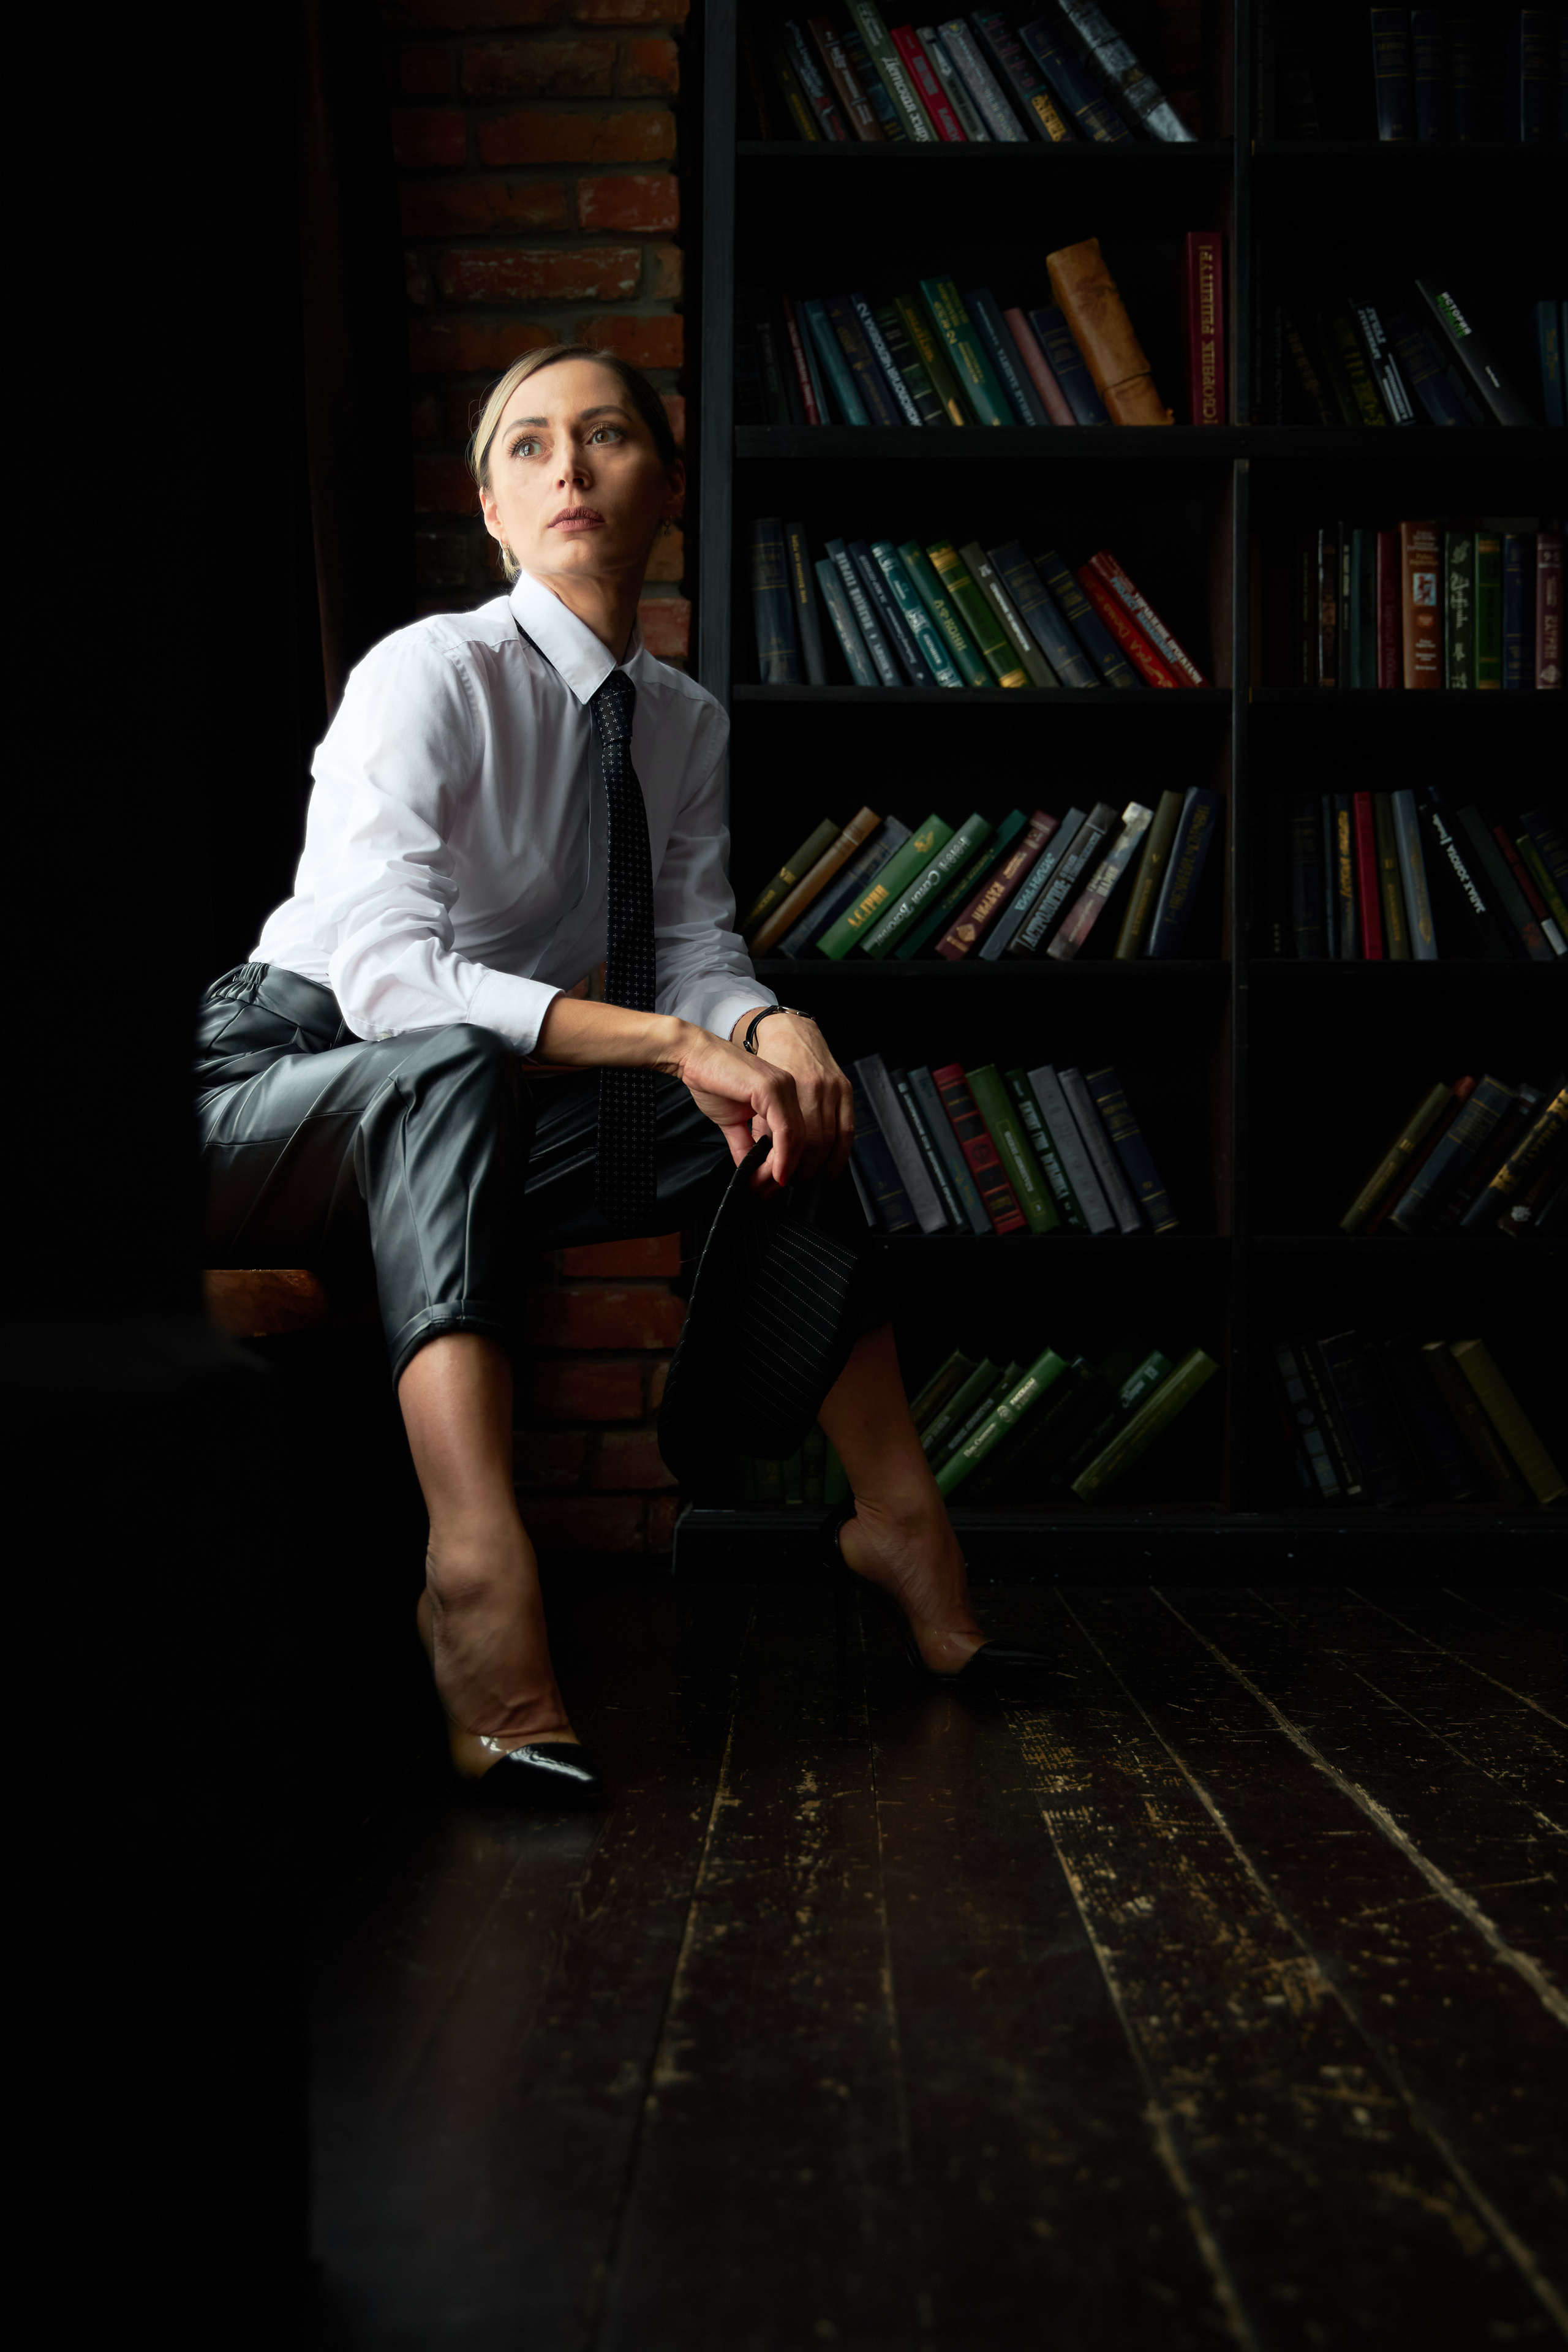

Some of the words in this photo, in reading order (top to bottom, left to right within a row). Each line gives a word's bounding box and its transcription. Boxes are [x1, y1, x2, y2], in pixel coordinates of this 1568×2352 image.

[1199, 250, 1214, 334] РЕЦЕПТУР
[1437, 290, 1476, 336] ИСТОРИЯ
[1200, 340, 1215, 418] СБОРНИК
[1108, 575, 1140, 612] PROJECT
[1133, 610, 1179, 665] MANAGEMENT
[1443, 843, 1471, 883] ЗОЛОТА
[969, 879, 1007, 924] КАТРИН
[1012, 886, 1036, 914] РИД
[1461, 879, 1487, 914] ЗАПАХ
